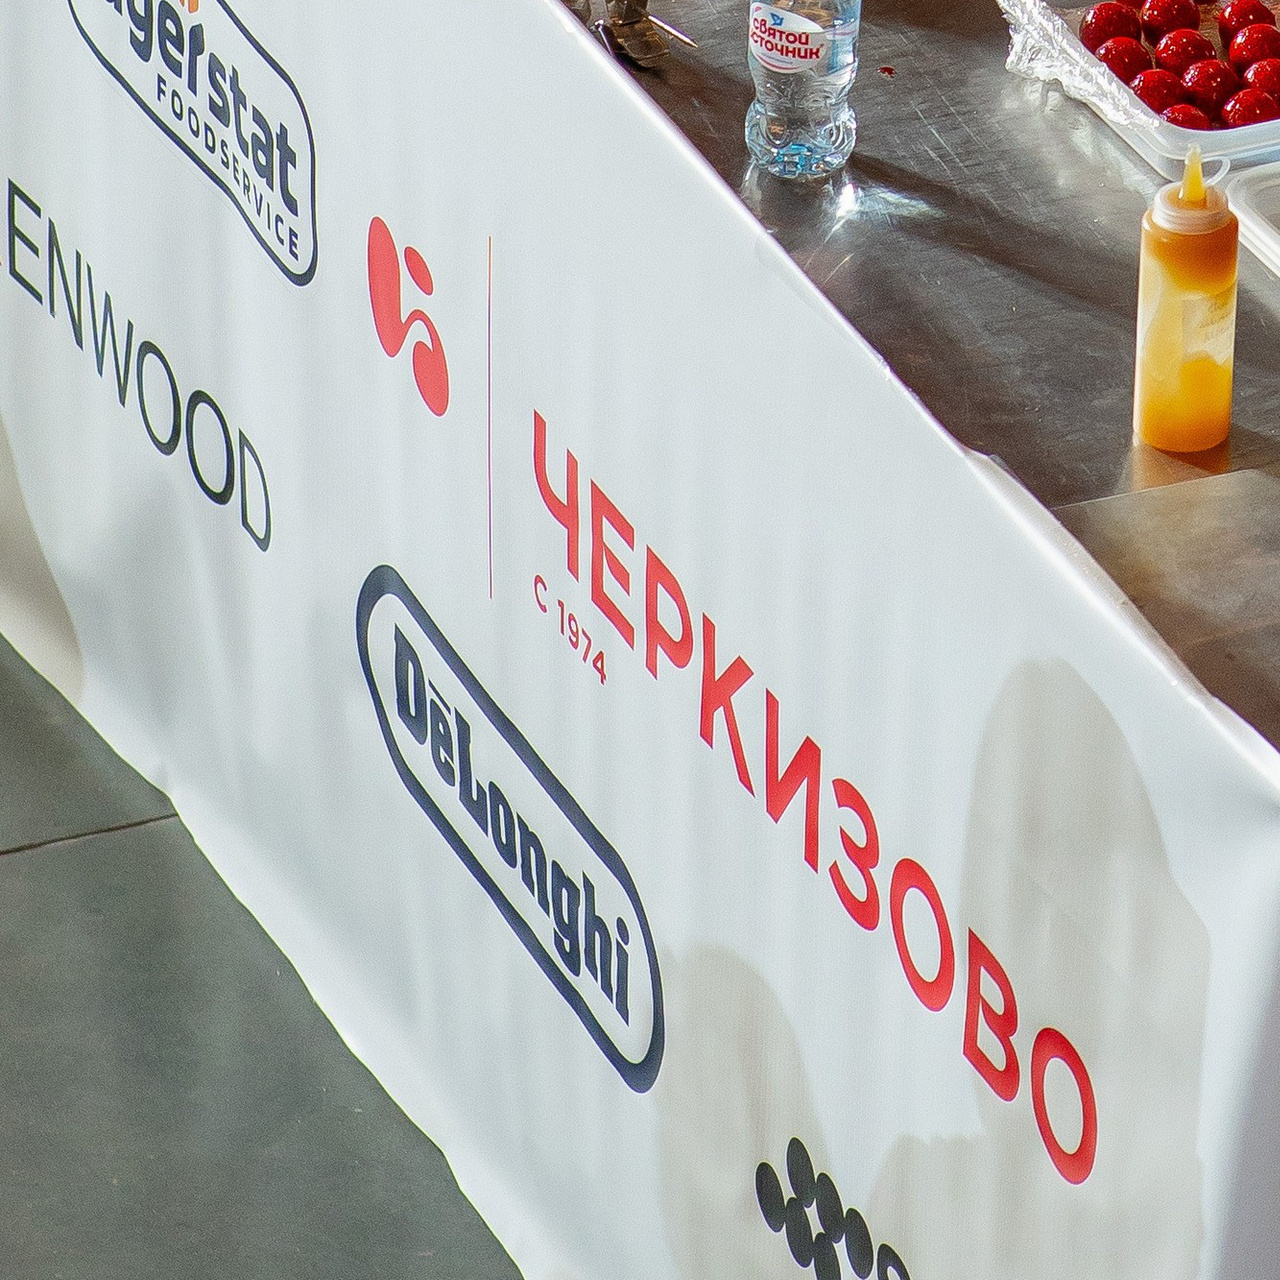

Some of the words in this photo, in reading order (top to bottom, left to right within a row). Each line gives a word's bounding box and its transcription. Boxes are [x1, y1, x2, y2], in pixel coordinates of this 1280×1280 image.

[157, 72, 299, 262] FOODSERVICE
[557, 599, 607, 685] 1974
[533, 410, 1098, 1185] ЧЕРКИЗОВО
